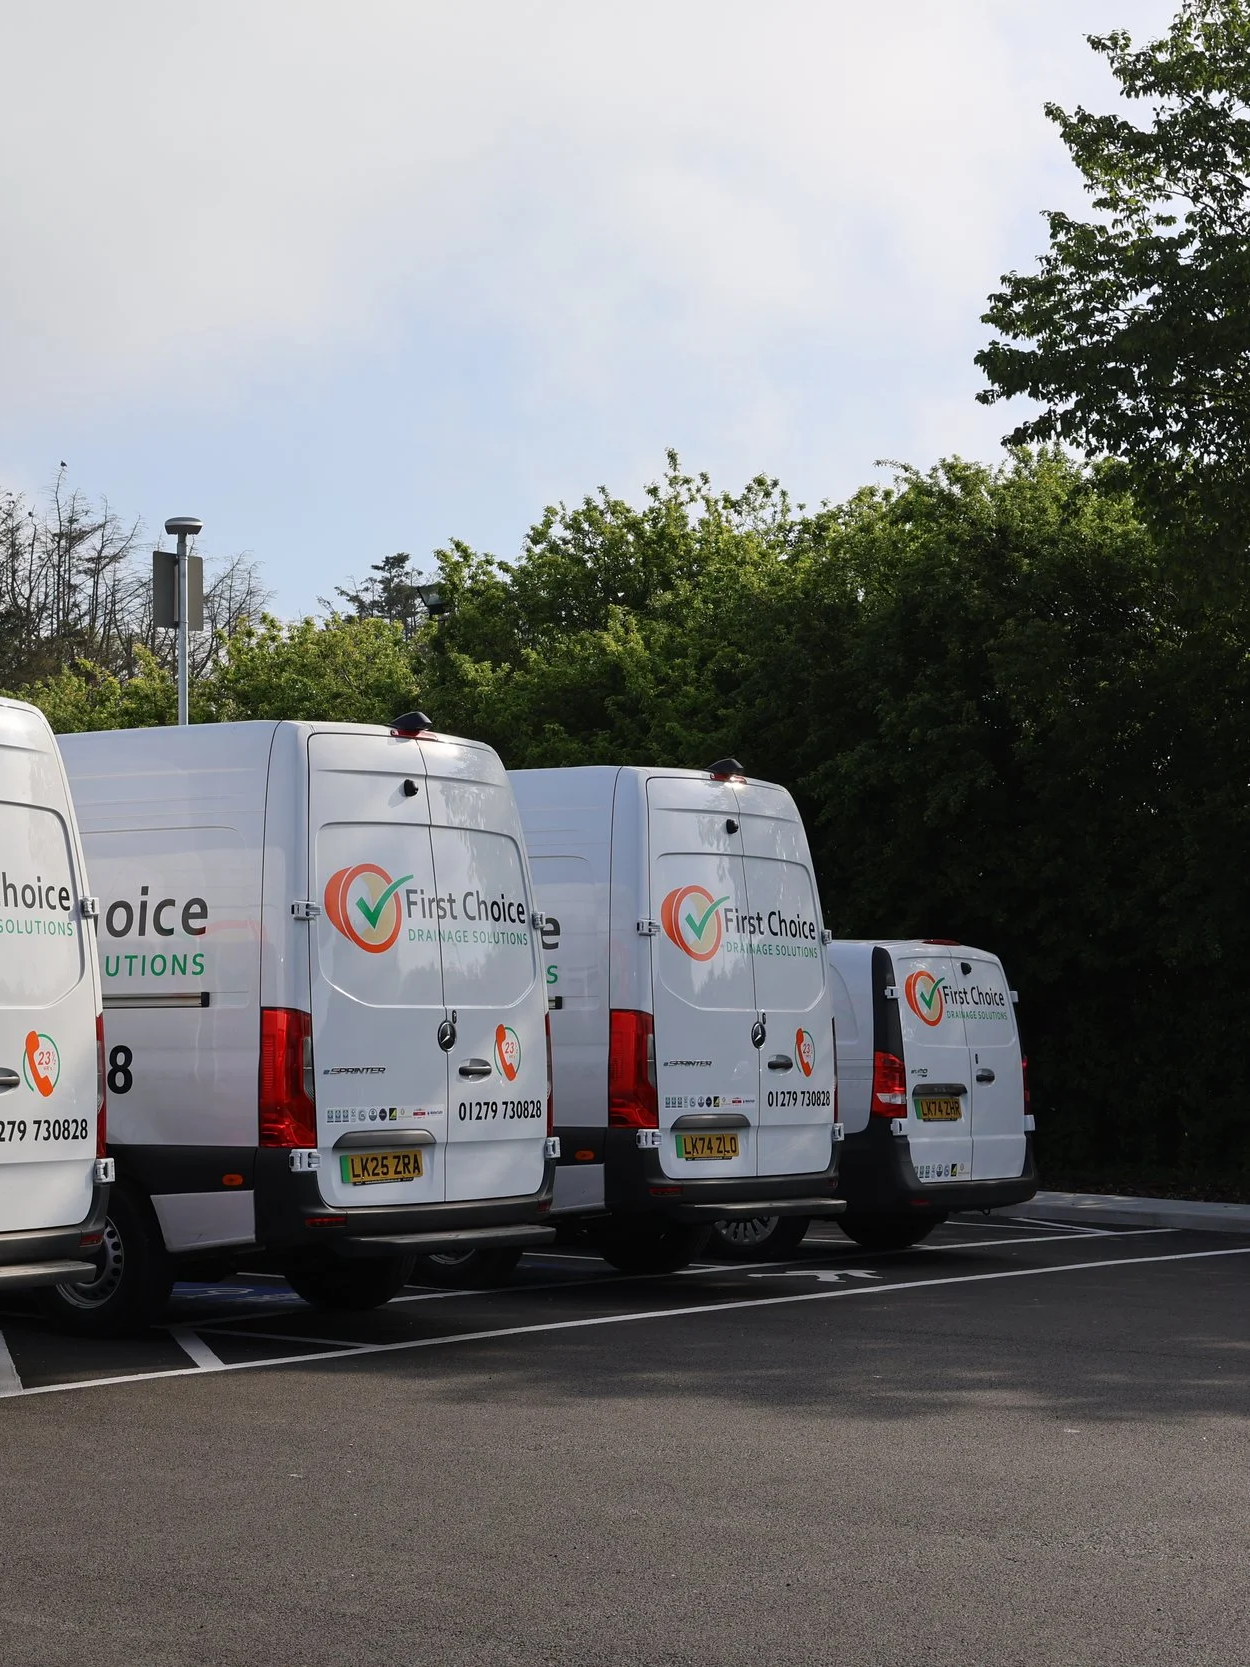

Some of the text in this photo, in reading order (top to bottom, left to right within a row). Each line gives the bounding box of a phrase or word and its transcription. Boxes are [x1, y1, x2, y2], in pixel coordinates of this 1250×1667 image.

[105, 885, 209, 938] oice
[405, 889, 526, 924] First Choice
[724, 908, 816, 940] First Choice
[408, 928, 469, 943] DRAINAGE
[473, 931, 528, 946] SOLUTIONS
[726, 941, 818, 958] DRAINAGE SOLUTIONS
[105, 953, 205, 977] UTIONS
[942, 985, 1005, 1007] First Choice
[947, 1010, 1008, 1020] DRAINAGE SOLUTIONS
[767, 1090, 798, 1107] 01279
[800, 1090, 831, 1107] 730828
[921, 1100, 944, 1116] LK74
[458, 1099, 542, 1121] 01279 730828
[32, 1118, 89, 1142] 730828
[683, 1137, 714, 1155] LK74
[351, 1154, 421, 1178] LK25 ZRA
